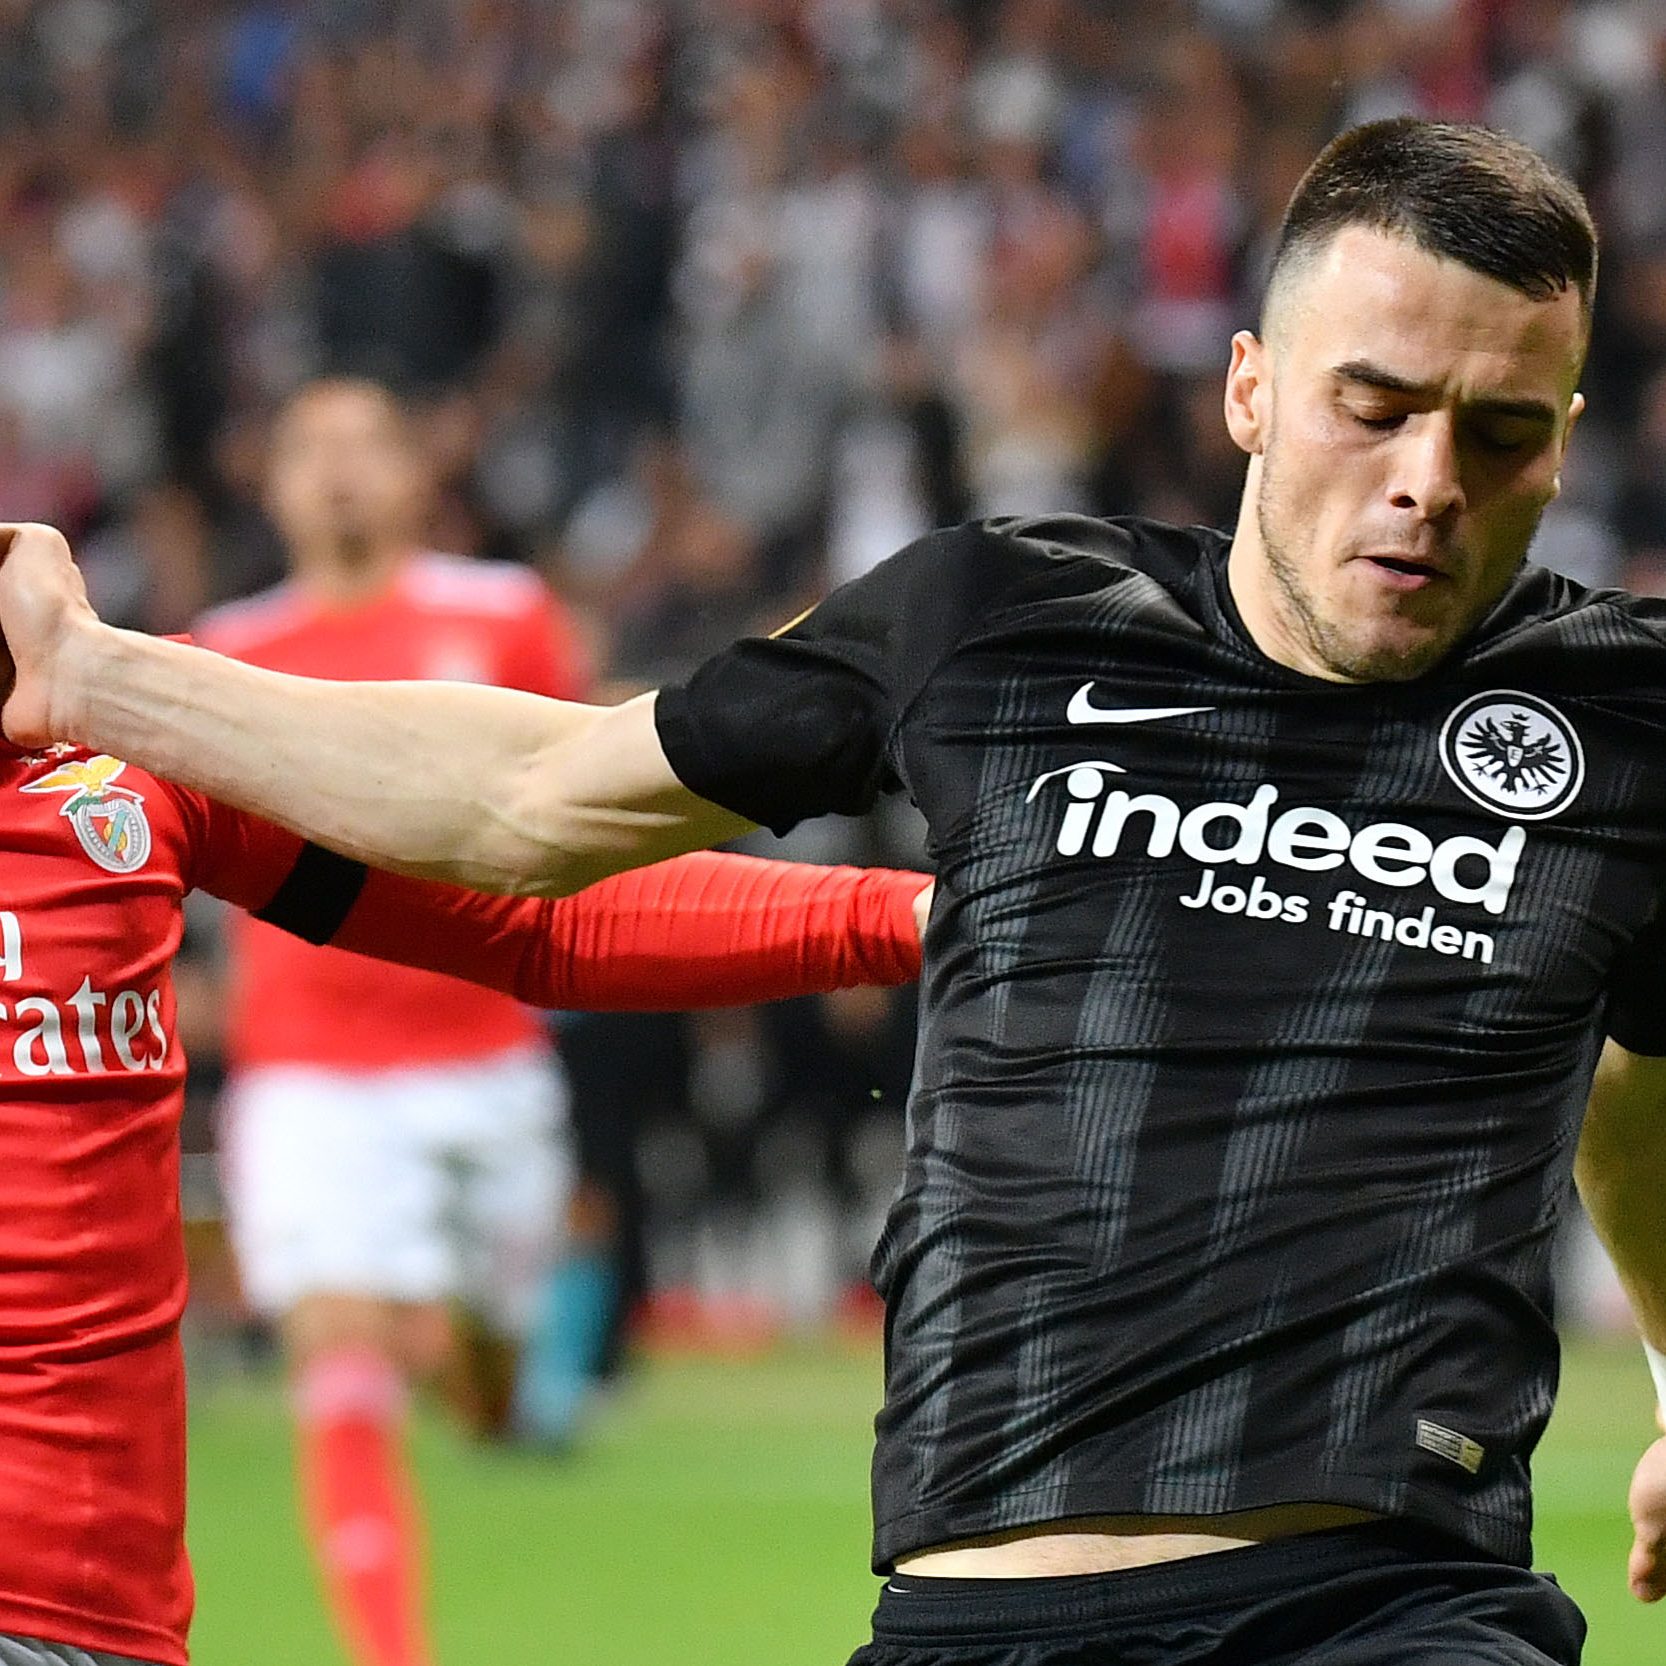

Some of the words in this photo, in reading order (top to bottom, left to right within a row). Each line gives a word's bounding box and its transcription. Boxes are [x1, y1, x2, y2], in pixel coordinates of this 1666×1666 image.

[1027, 761, 1526, 914] indeed
[1179, 870, 1309, 924] Jobs
[1327, 890, 1495, 964] finden
